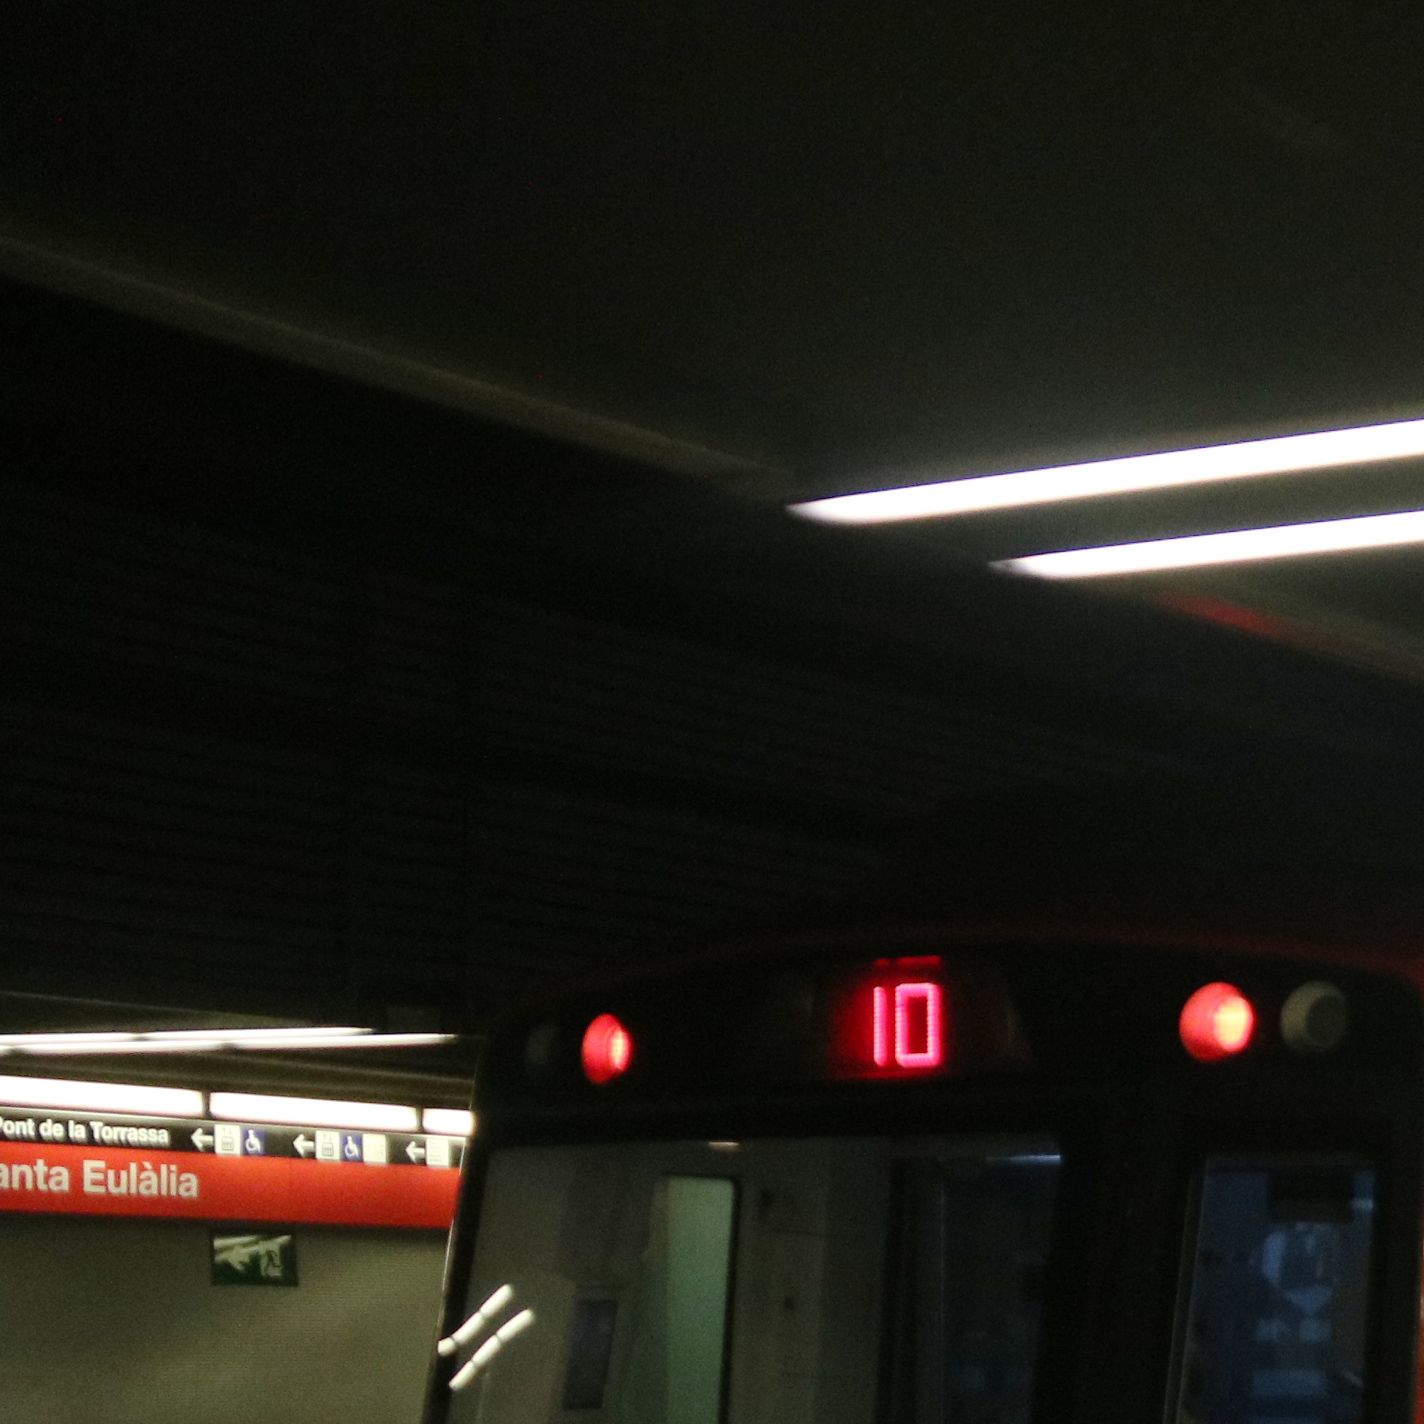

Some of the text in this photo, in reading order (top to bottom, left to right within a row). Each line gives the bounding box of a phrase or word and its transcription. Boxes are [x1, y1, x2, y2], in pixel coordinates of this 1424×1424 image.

[873, 982, 941, 1069] 10
[39, 1118, 65, 1139] de
[68, 1119, 87, 1141] la
[90, 1121, 170, 1145] Torrassa
[83, 1159, 200, 1198] Eulàlia
